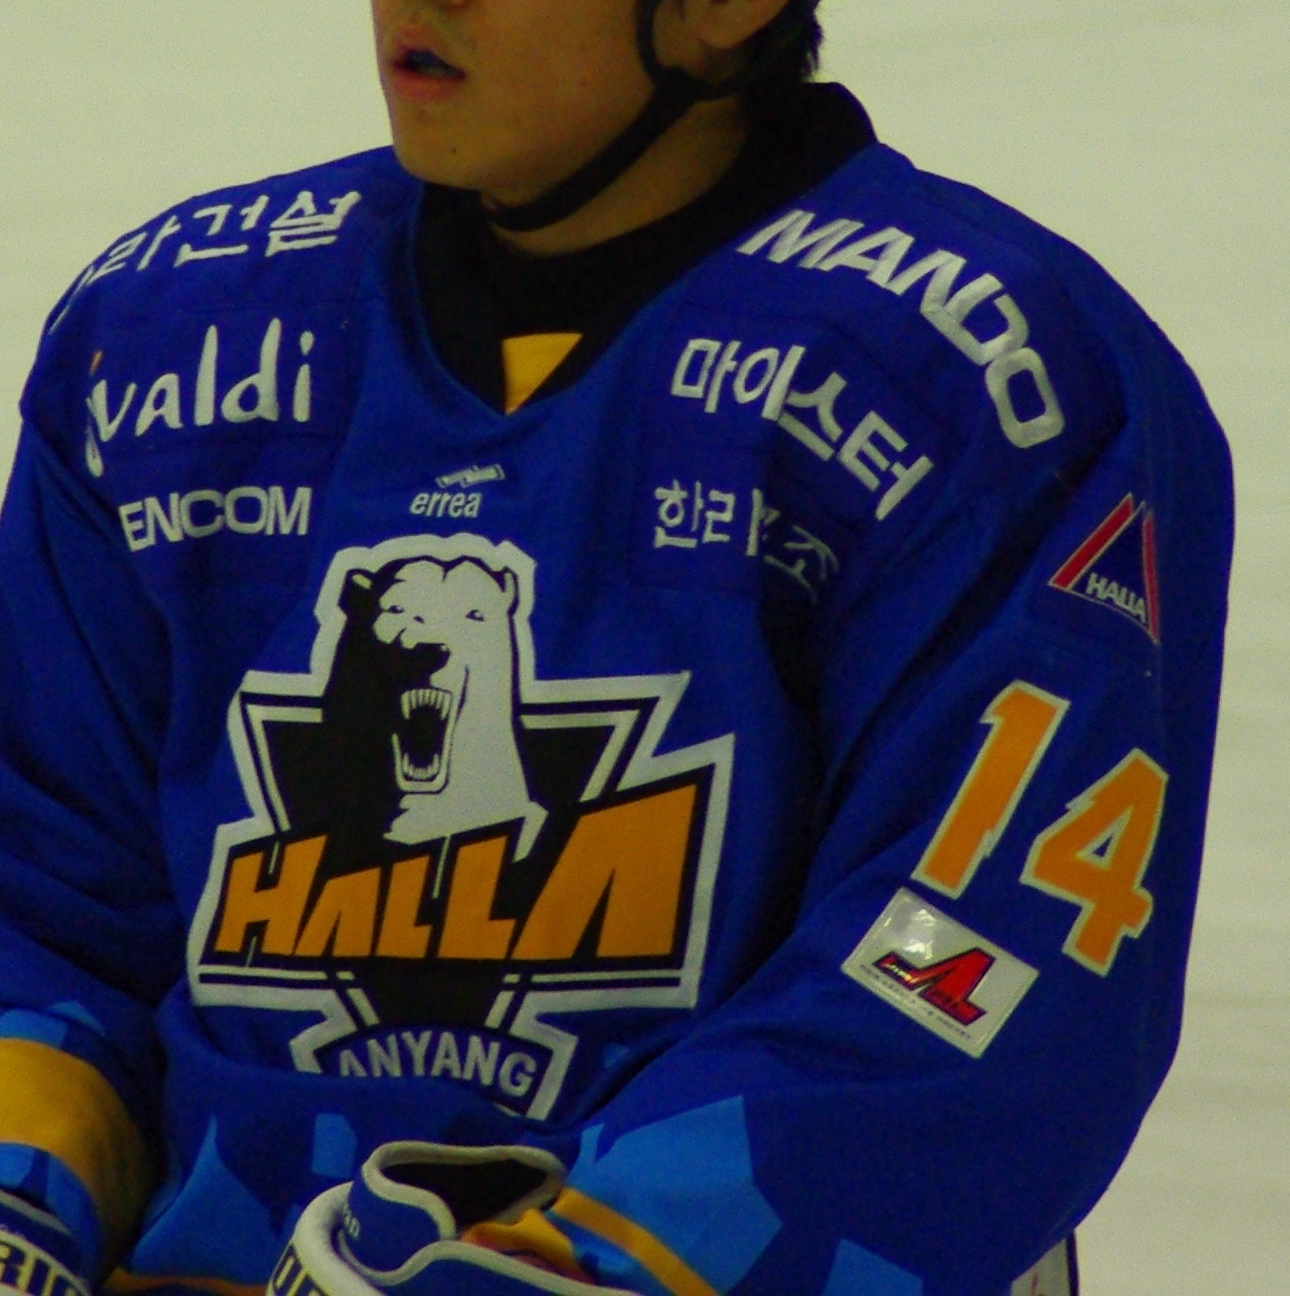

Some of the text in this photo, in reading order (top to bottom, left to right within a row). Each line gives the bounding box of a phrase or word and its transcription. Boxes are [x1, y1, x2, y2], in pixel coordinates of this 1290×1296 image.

[48, 190, 363, 336] 라건설
[736, 209, 1066, 449] MANDO
[670, 337, 934, 522] 마이스터
[213, 783, 699, 961] HALLA
[910, 679, 1170, 977] 14
[339, 1030, 538, 1098] ANYANG
